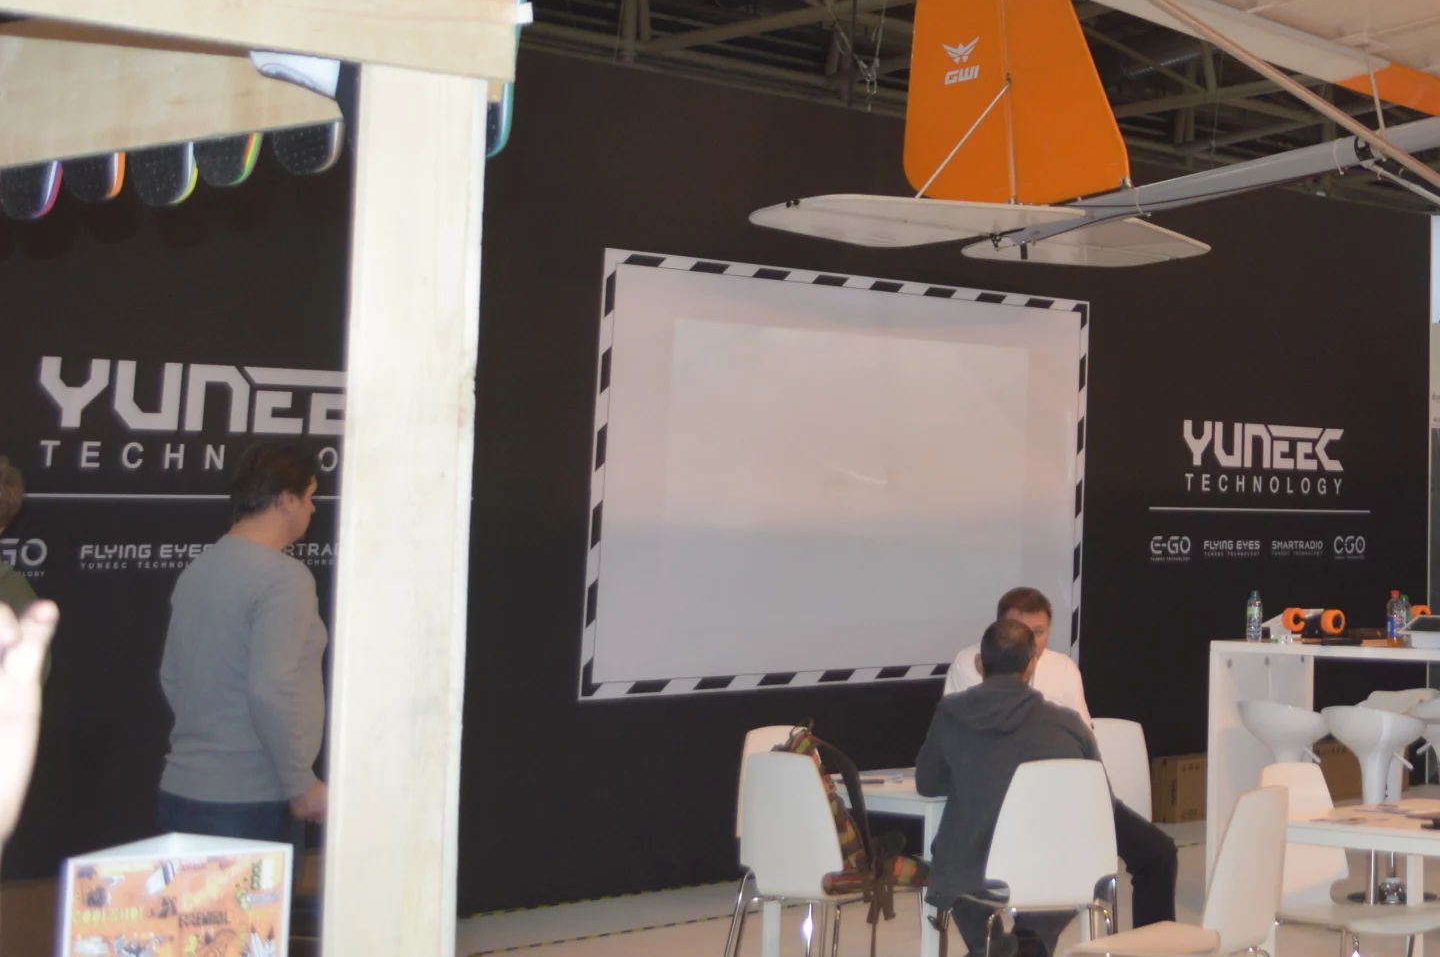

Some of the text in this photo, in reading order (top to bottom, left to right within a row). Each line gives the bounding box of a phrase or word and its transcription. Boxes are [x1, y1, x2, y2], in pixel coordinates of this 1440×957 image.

[944, 65, 980, 85] GWI
[40, 356, 347, 434] YUNEE
[1183, 419, 1345, 472] YUNEEC
[1185, 473, 1342, 495] TECHNOLOGY
[80, 544, 152, 559] FLYING
[1150, 536, 1366, 554] E-GO FLYING EYES SMARTRADIO CGO
[80, 561, 128, 570] YUNEEC
